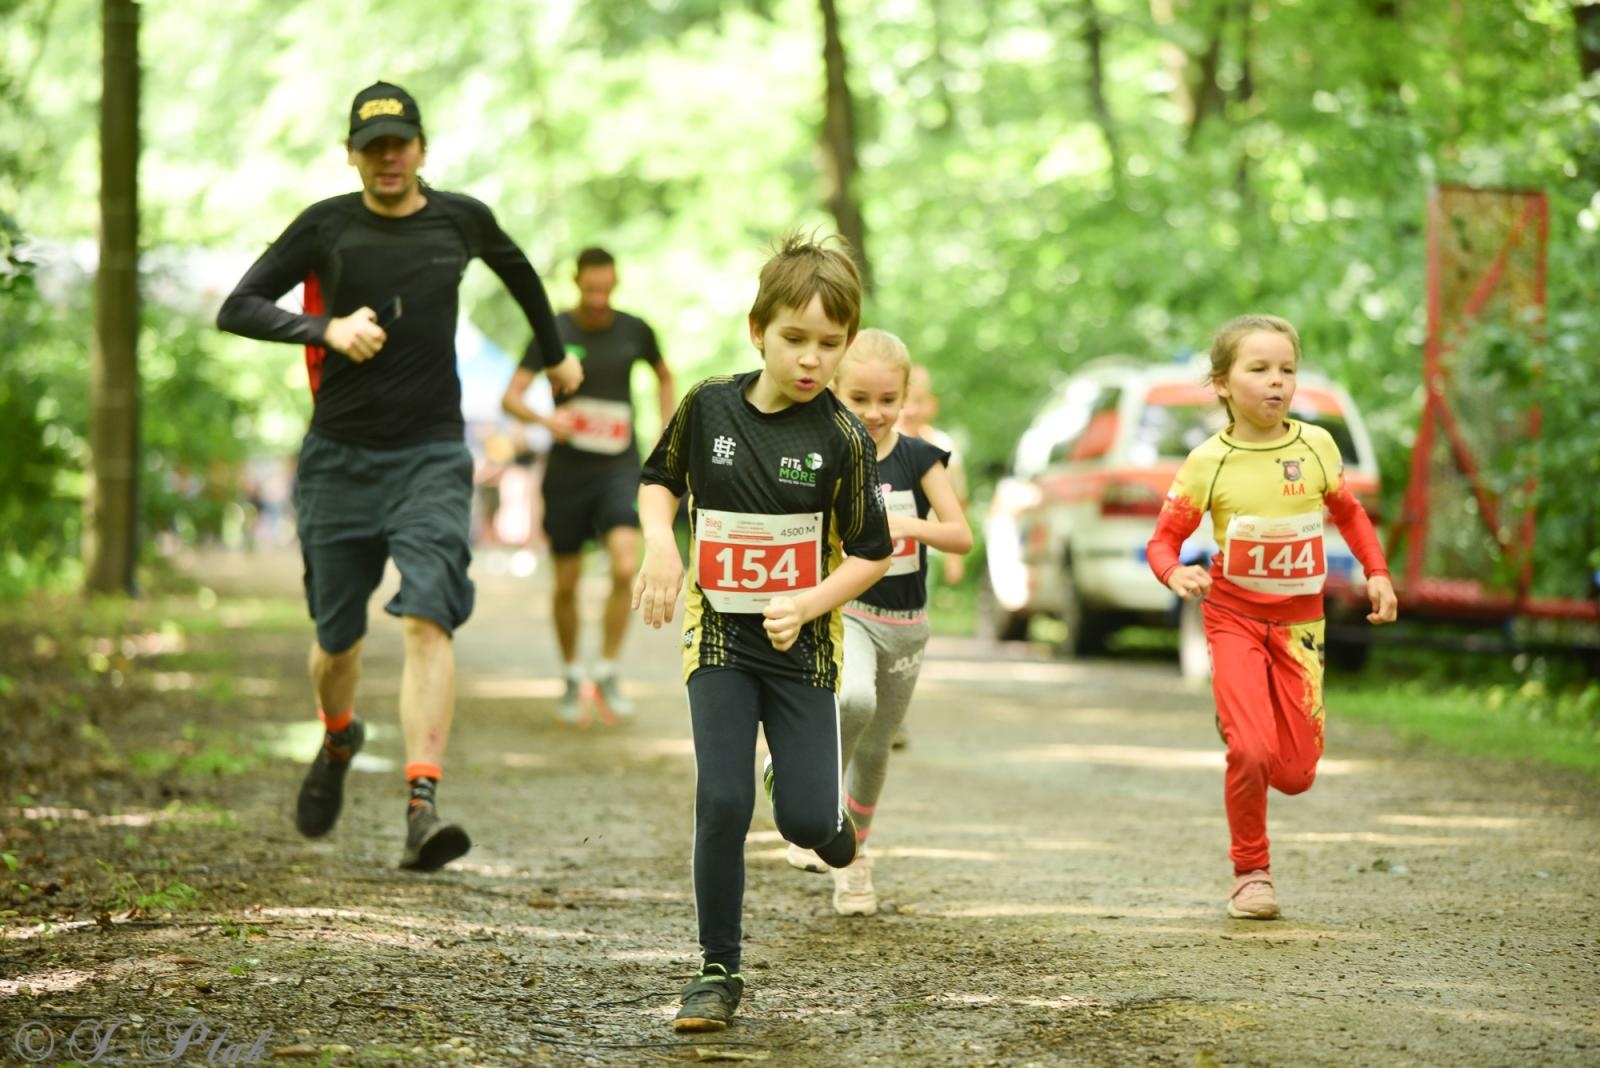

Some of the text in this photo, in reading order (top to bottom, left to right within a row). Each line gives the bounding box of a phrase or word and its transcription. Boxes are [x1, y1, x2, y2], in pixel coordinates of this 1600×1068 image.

[779, 467, 817, 483] MORE
[1283, 483, 1306, 496] ALA
[780, 527, 804, 537] 4500
[806, 526, 816, 534] M
[1247, 541, 1316, 577] 144
[715, 547, 800, 589] 154
